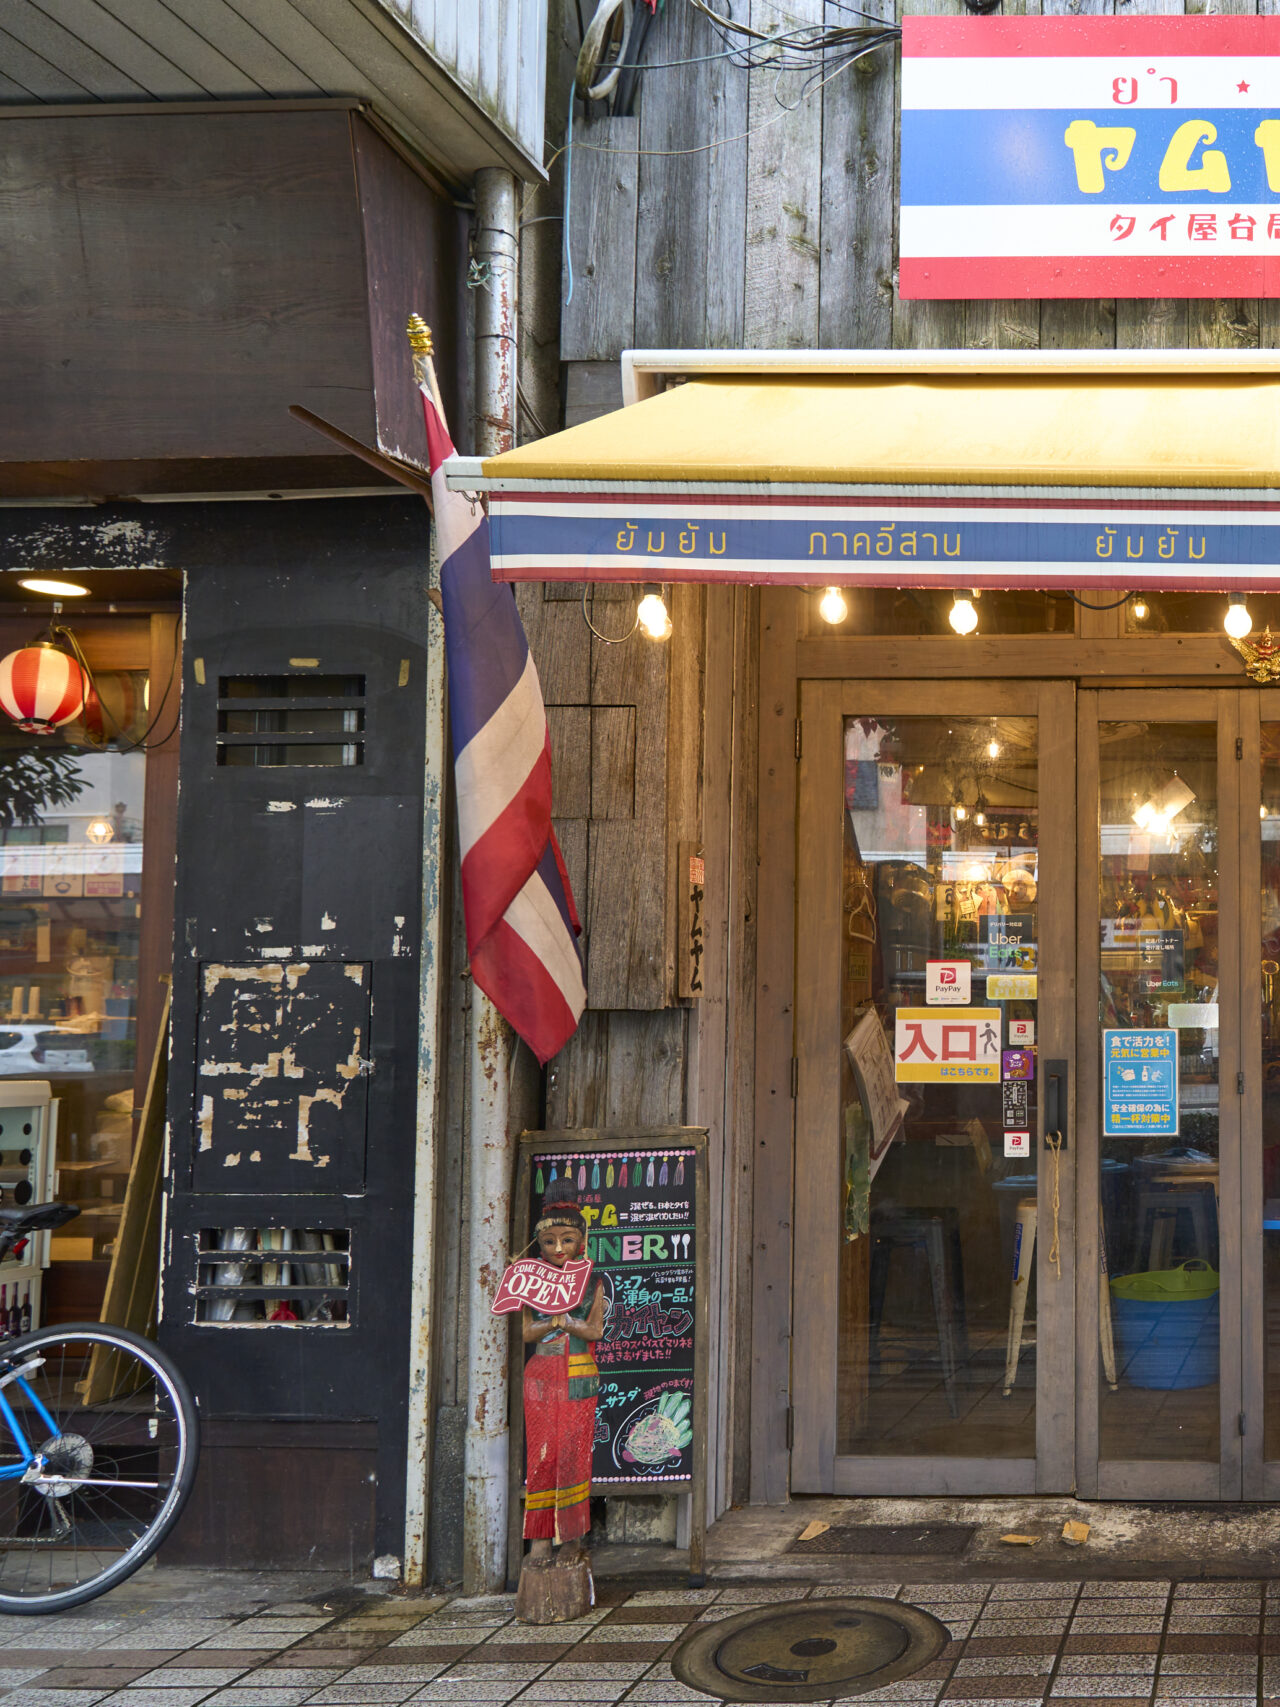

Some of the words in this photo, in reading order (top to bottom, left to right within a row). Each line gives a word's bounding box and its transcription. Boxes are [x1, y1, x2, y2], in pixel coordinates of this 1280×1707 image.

[1112, 67, 1178, 105] ยำ
[808, 521, 962, 557] ภาคอีสาน
[989, 932, 1022, 945] Uber
[989, 945, 1023, 958] Eats
[935, 985, 961, 993] PayPay
[898, 1023, 978, 1062] 入口
[940, 1066, 995, 1077] はこちらです。
[513, 1264, 537, 1274] COME
[547, 1271, 560, 1282] WE
[558, 1273, 577, 1284] ARE
[614, 1274, 643, 1291] シェフ
[507, 1272, 577, 1306] OPEN
